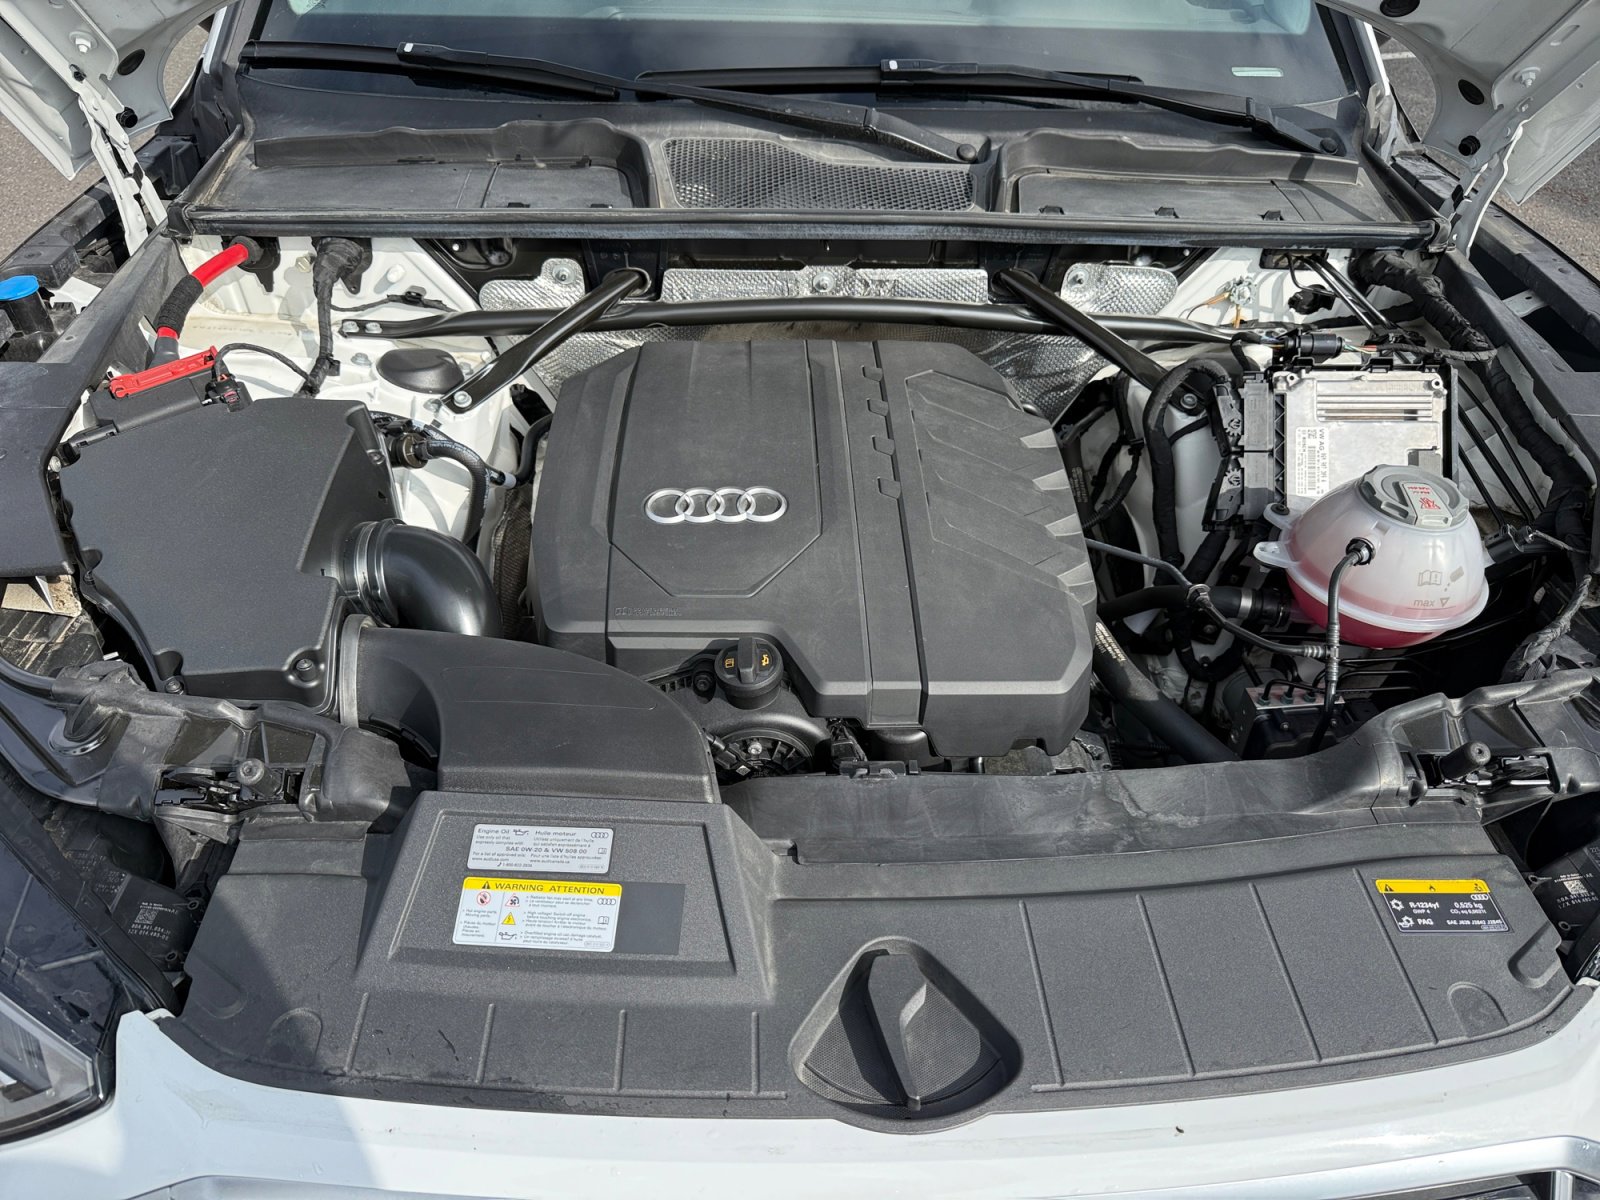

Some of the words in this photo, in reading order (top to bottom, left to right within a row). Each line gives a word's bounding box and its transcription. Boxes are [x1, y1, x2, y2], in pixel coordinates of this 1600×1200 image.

[1319, 428, 1325, 439] VW
[1319, 441, 1325, 451] AG
[495, 882, 544, 891] WARNING
[549, 885, 605, 894] ATTENTION
[1409, 902, 1440, 910] R-1234yf
